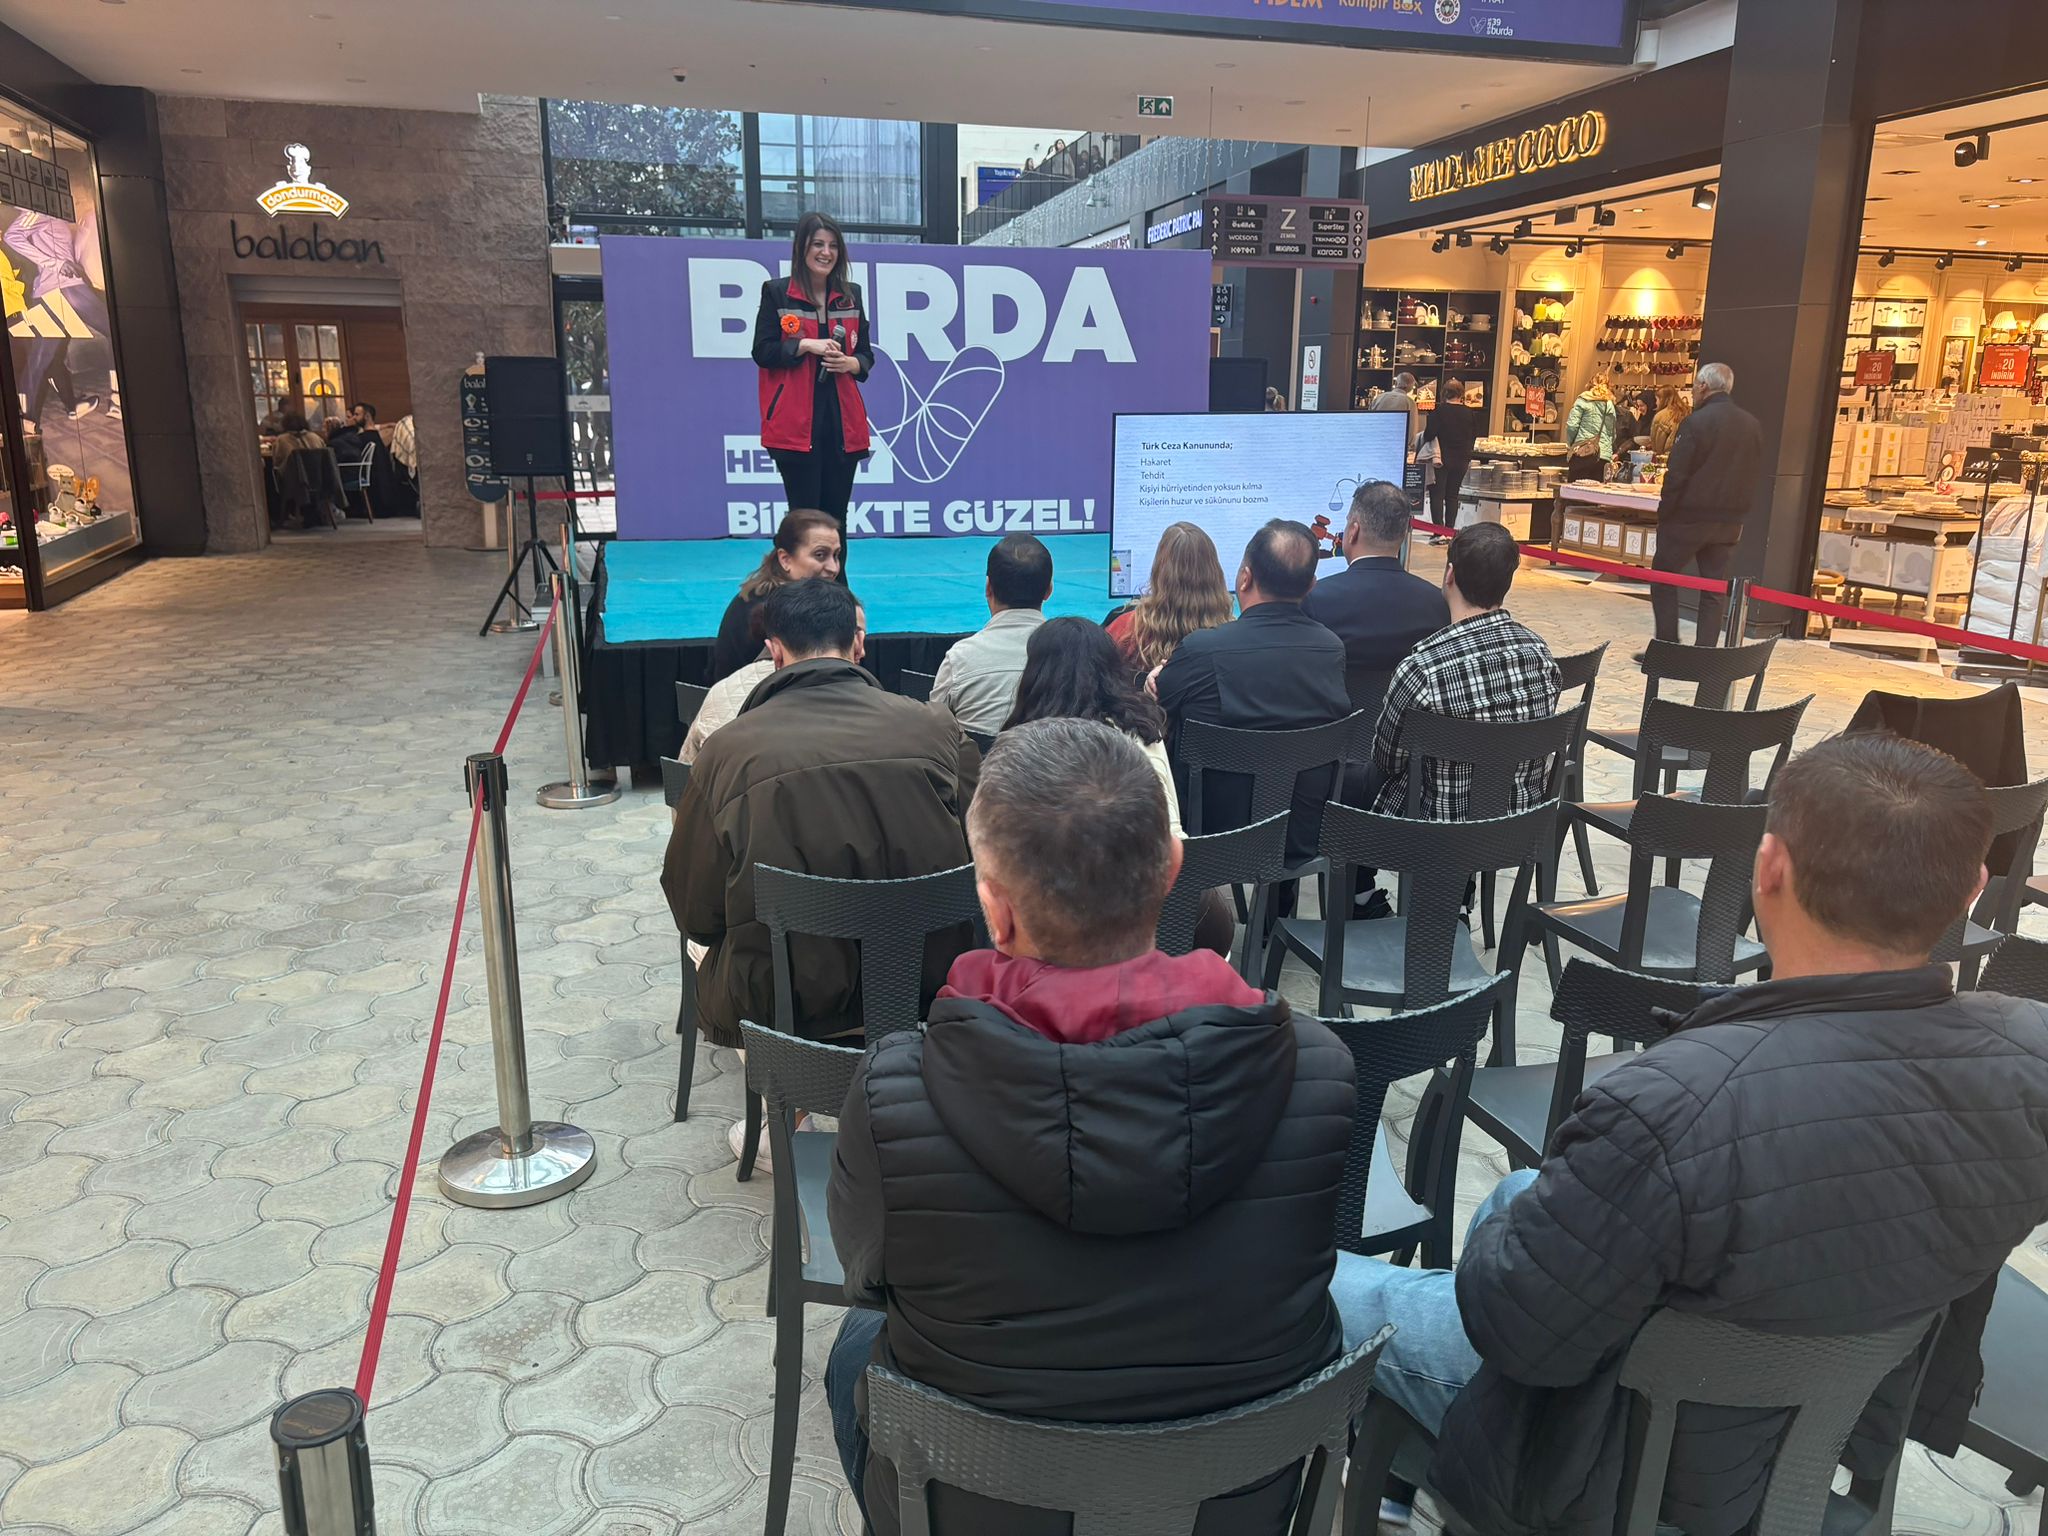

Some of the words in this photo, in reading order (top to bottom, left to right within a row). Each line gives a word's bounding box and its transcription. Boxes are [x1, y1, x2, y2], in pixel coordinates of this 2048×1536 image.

[1491, 24, 1514, 36] burda
[1409, 137, 1516, 202] MADAME
[1517, 110, 1608, 174] COCO
[1280, 208, 1297, 230] Z
[1317, 223, 1345, 232] SuperStep
[230, 218, 385, 264] balaban
[1228, 234, 1259, 242] watsons
[688, 257, 1137, 363] BRDA
[1142, 442, 1160, 450] Türk
[1161, 442, 1181, 450] Ceza
[1183, 441, 1233, 450] Kanununda;
[727, 449, 780, 474] HE
[1140, 458, 1172, 467] Hakaret
[1141, 471, 1165, 480] Tehdit
[1139, 485, 1160, 494] Kişiyi
[1161, 484, 1213, 493] hürriyetinden
[1213, 484, 1241, 493] yoksun
[1242, 482, 1263, 491] kılma
[1139, 497, 1170, 507] Kişilerin
[1171, 497, 1193, 505] huzur
[1243, 495, 1269, 504] bozma
[727, 501, 931, 534] BİKTE
[943, 498, 1095, 533] GÜZEL!
